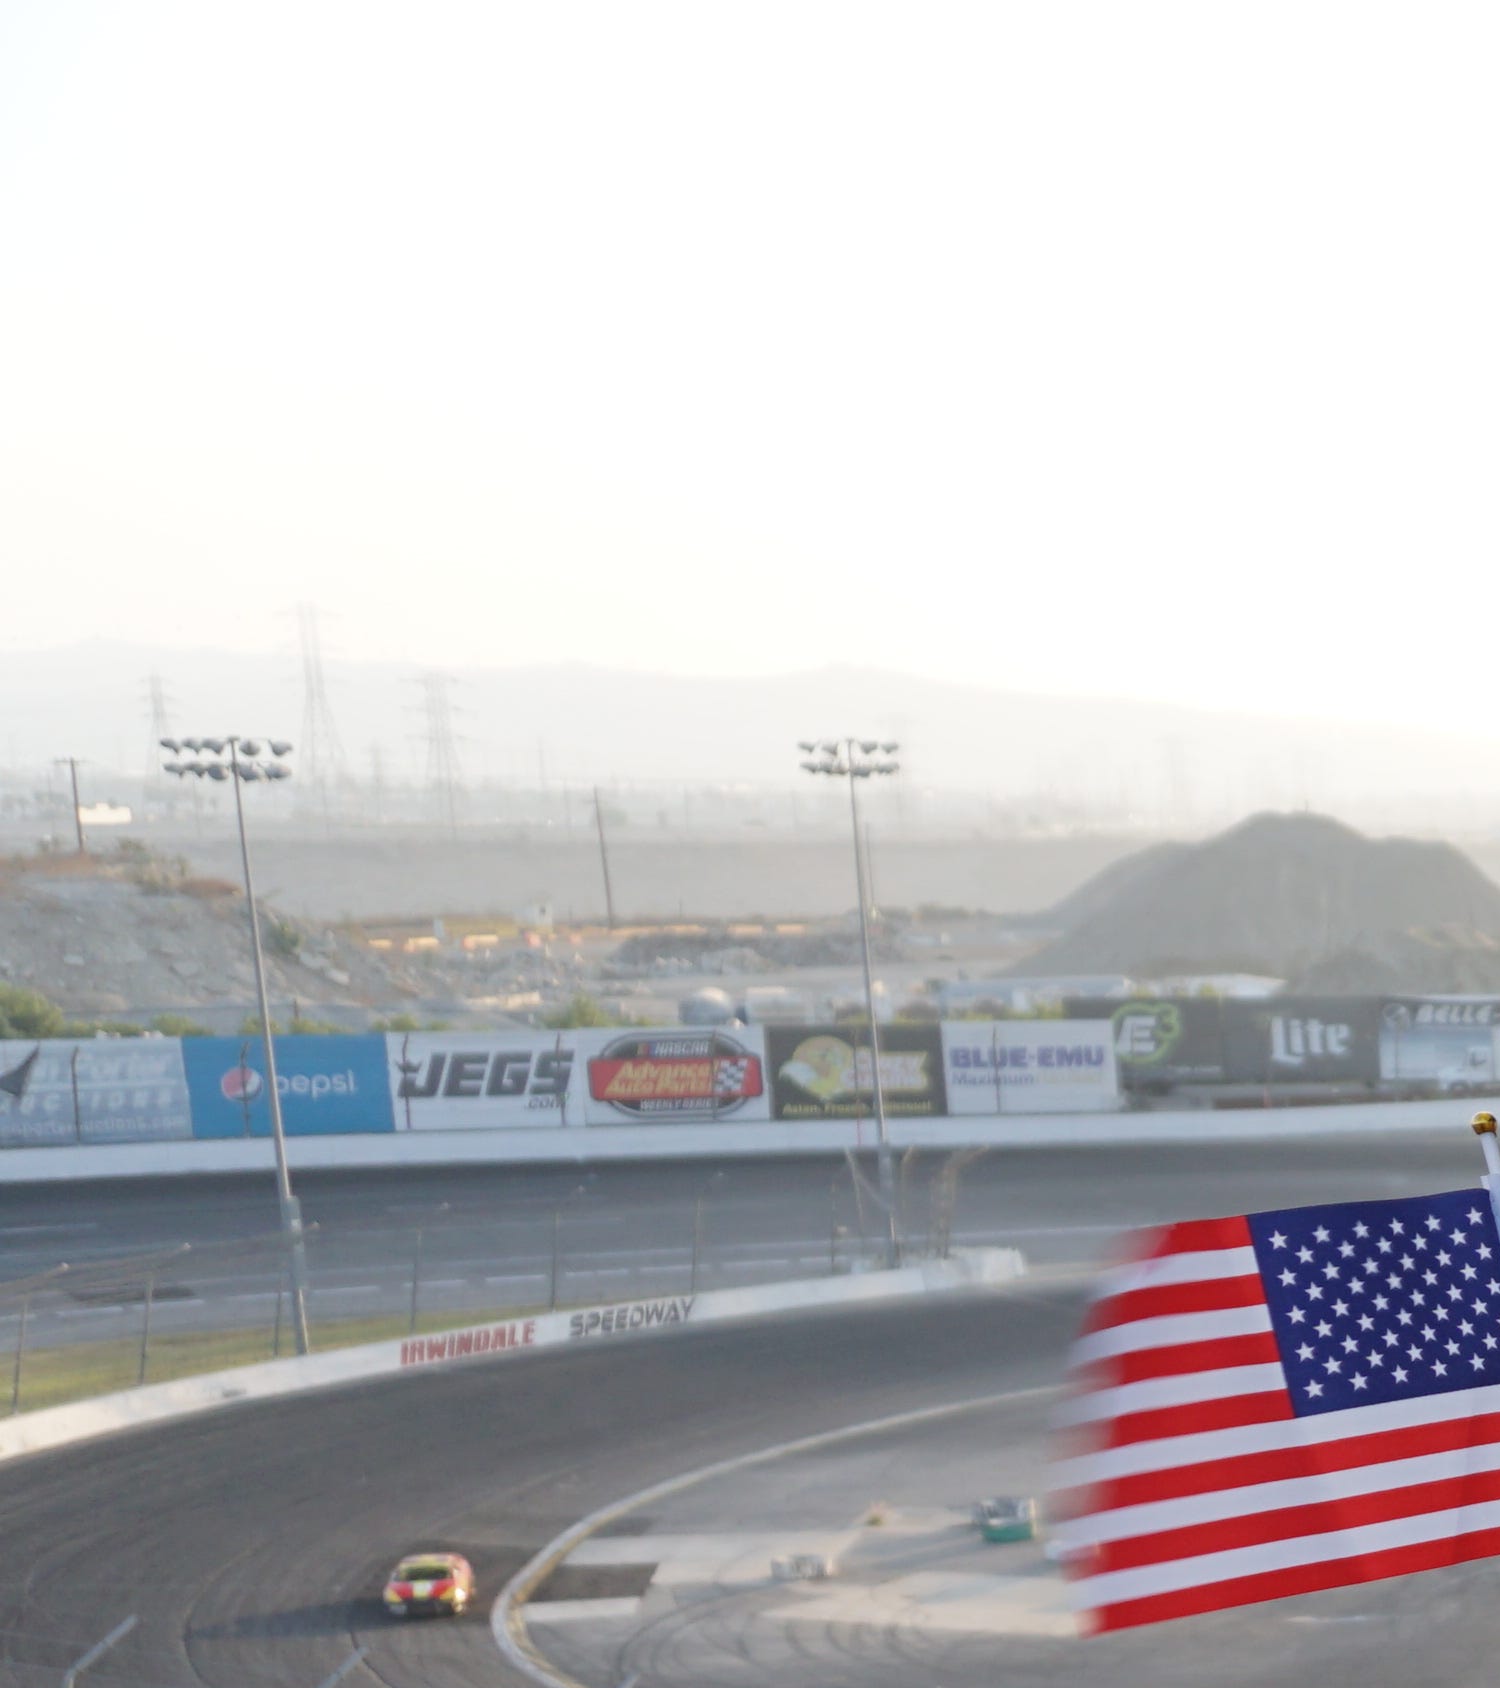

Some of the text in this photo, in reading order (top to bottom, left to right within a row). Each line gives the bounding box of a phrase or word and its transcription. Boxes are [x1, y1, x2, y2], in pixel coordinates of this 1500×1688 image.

[1271, 1016, 1353, 1067] Lite
[275, 1069, 355, 1100] pepsi
[396, 1050, 575, 1098] JEGS
[400, 1296, 696, 1366] IRWINDALE SPEEDWAY
